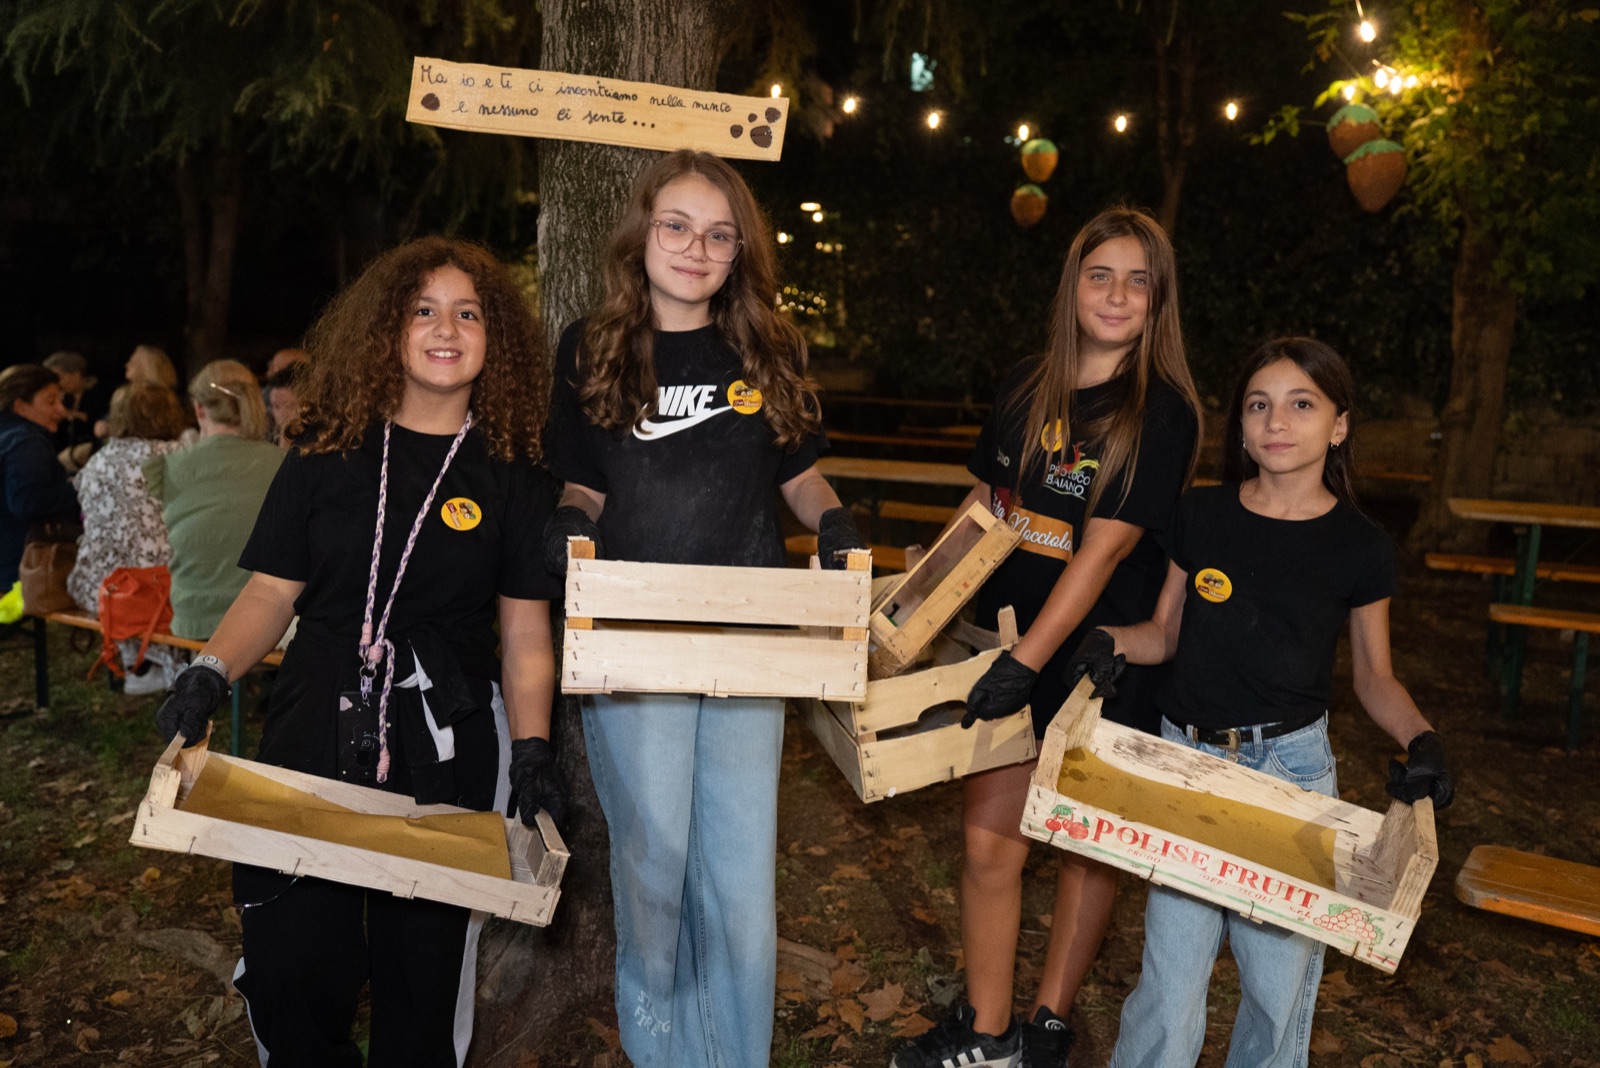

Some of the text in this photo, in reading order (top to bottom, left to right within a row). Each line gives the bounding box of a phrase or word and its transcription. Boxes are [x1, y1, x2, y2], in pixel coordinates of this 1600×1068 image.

[420, 64, 448, 85] Ma
[460, 73, 476, 88] io
[483, 77, 494, 89] e
[528, 78, 544, 94] ci
[555, 80, 639, 102] incontriamo
[649, 94, 687, 108] nella
[451, 100, 469, 114] e
[478, 103, 540, 117] nessuno
[658, 384, 718, 417] NIKE
[1046, 473, 1085, 496] BAIANO
[1048, 463, 1067, 477] PRO
[1090, 816, 1320, 909] POLISE FRUIT
[634, 1005, 658, 1037] FIRE
